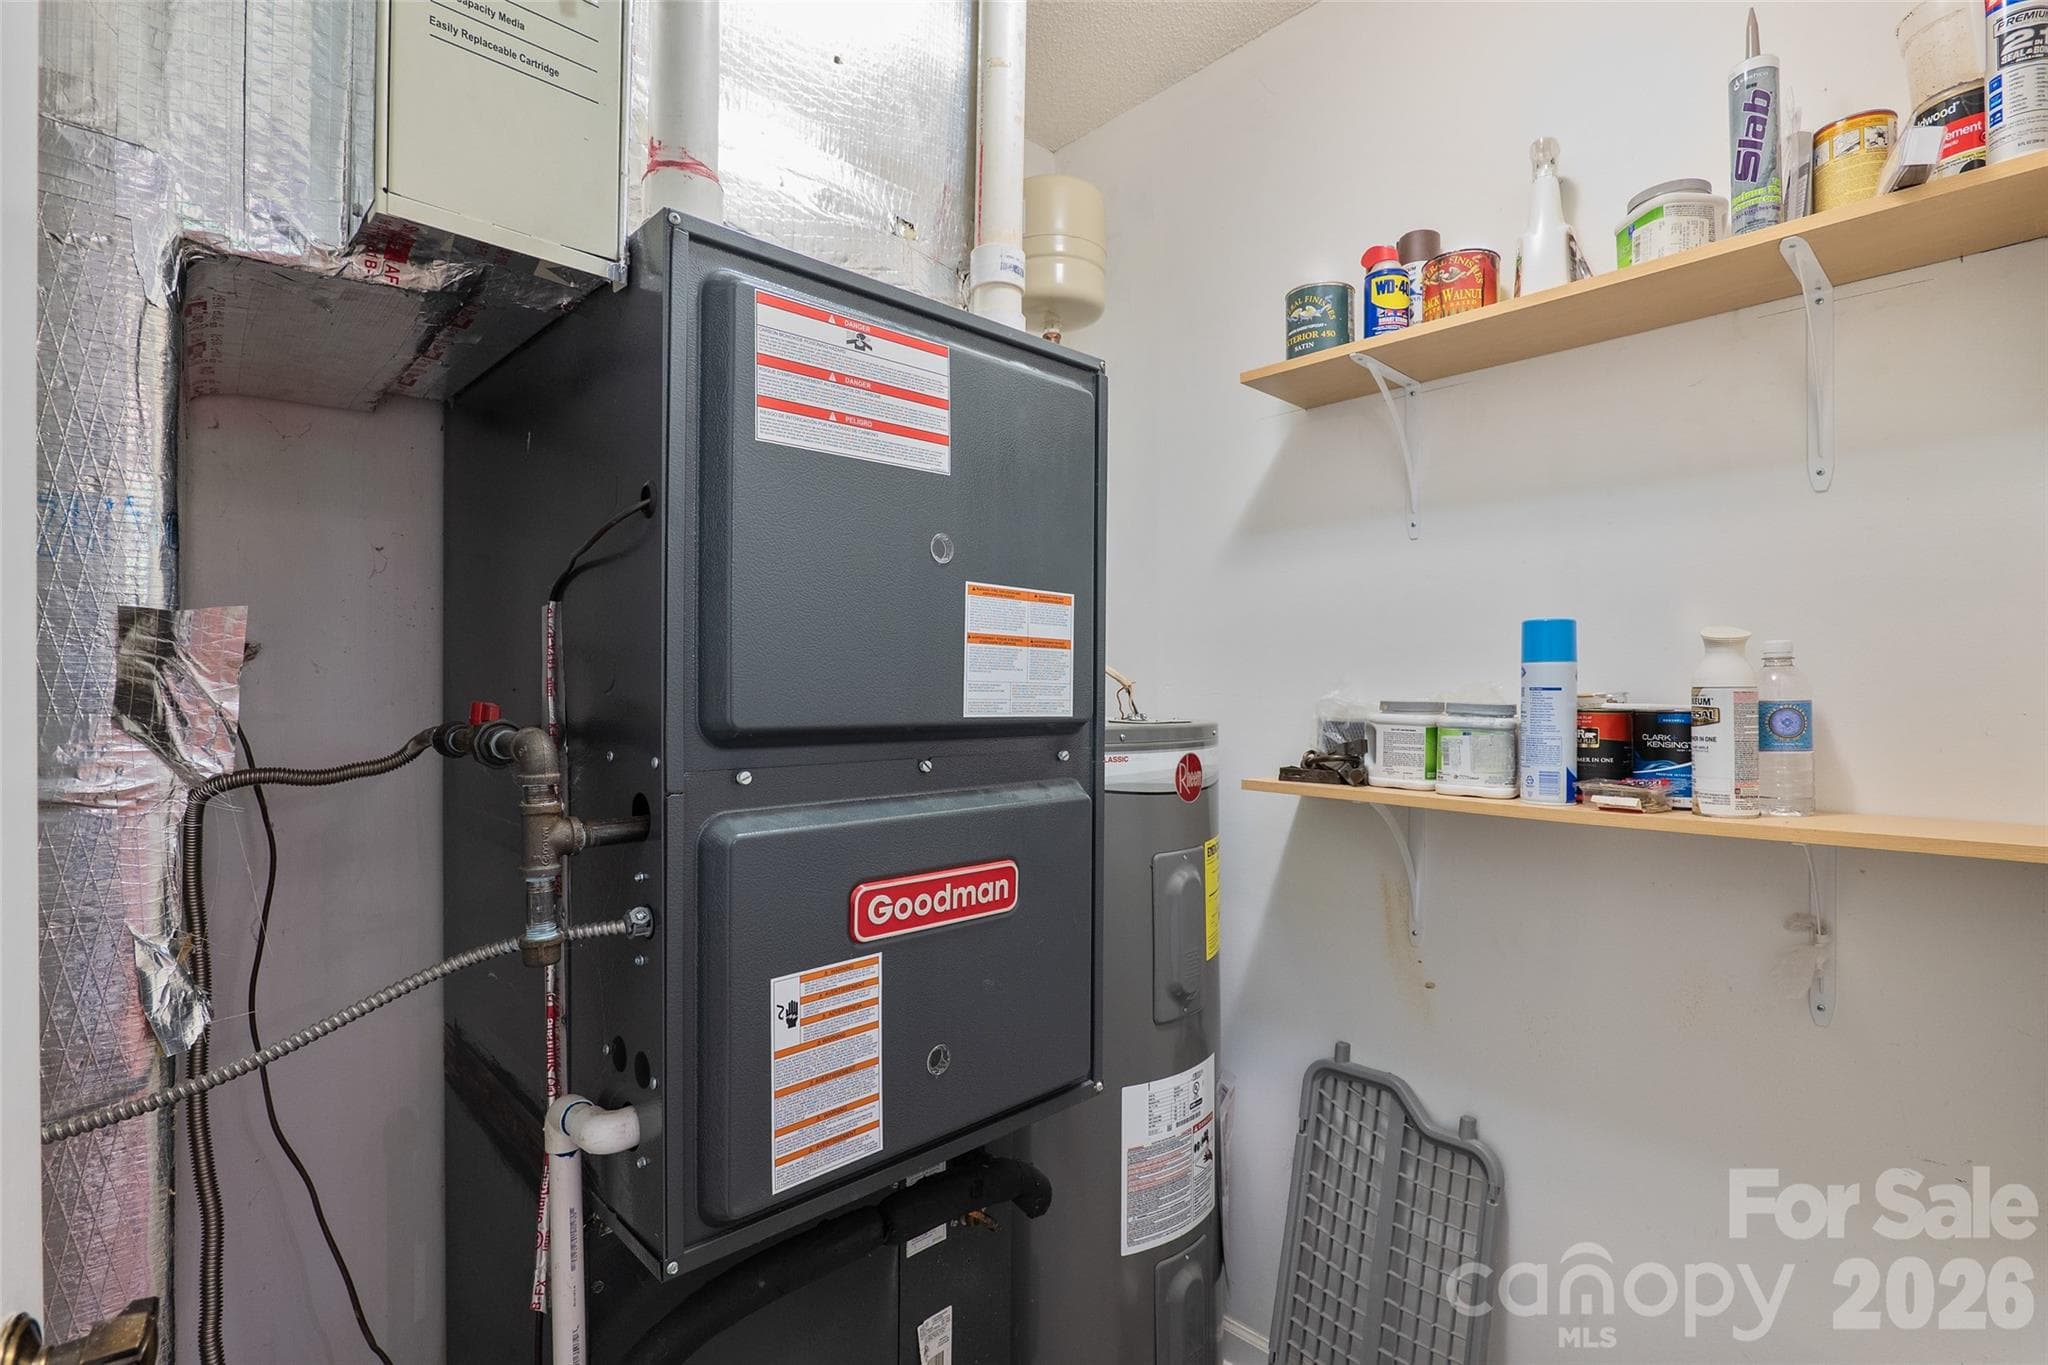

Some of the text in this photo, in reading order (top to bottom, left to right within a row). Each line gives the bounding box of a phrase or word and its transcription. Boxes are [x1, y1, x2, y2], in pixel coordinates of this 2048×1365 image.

[456, 0, 525, 31] apacity Media
[1998, 10, 2048, 31] PREMIU
[428, 15, 560, 77] Easily Replaceable Cartridge
[2001, 48, 2026, 64] SEAL
[1917, 103, 1957, 127] ldwood
[1734, 89, 1772, 183] Slab
[1944, 121, 1983, 141] ement
[1441, 288, 1482, 303] WALNUT
[844, 319, 871, 333] DANGER
[1287, 330, 1319, 347] TERIOR
[1294, 341, 1314, 352] SATIN
[844, 377, 872, 389] DANGER
[845, 415, 873, 428] PELIGRO
[1641, 733, 1672, 741] CLARK
[1103, 755, 1129, 764] LASSIC
[1179, 755, 1202, 794] Rheem
[867, 878, 1009, 925] Goodman
